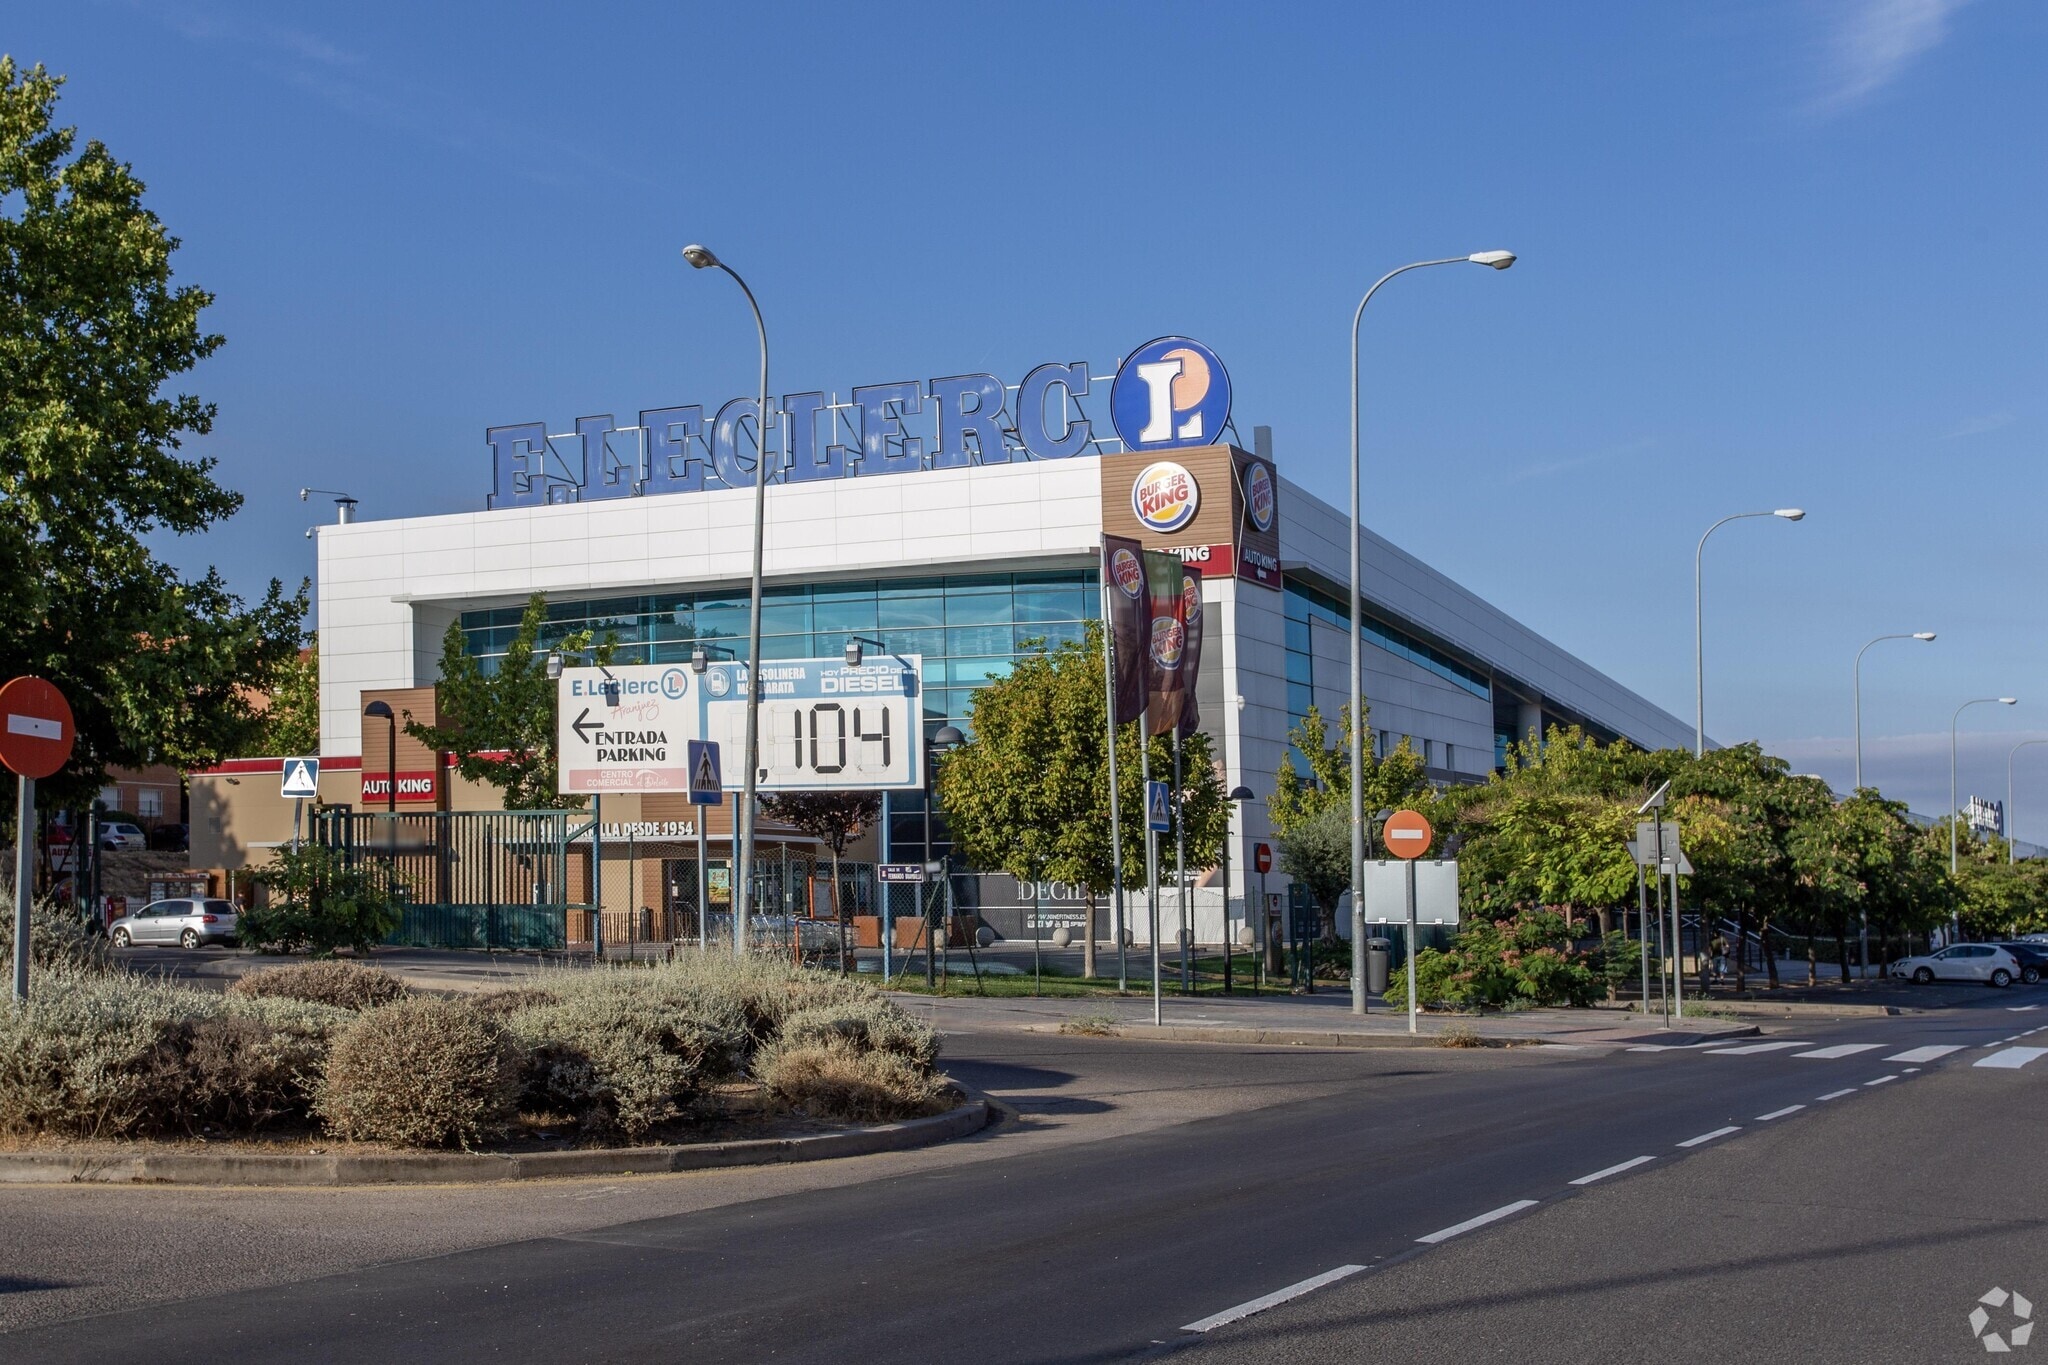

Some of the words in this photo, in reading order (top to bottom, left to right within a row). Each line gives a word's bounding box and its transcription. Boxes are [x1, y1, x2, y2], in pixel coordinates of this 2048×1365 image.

[1140, 473, 1186, 502] BURGER
[1253, 478, 1269, 496] BURGER
[1142, 484, 1189, 519] KING
[1254, 489, 1272, 513] KING
[1115, 560, 1138, 574] BURGER
[1118, 567, 1140, 587] KING
[1152, 627, 1182, 643] BURGER
[1154, 635, 1182, 657] KING
[736, 669, 748, 682] LA
[840, 665, 889, 676] PRECIO
[572, 678, 659, 697] E.Leclerc
[820, 674, 908, 694] DIESEL
[610, 699, 660, 721] Aranjuez
[595, 730, 668, 746] ENTRADA
[596, 747, 666, 762] PARKING
[600, 770, 634, 779] CENTRO
[398, 778, 432, 793] KING
[586, 779, 634, 788] COMERCIAL
[622, 821, 660, 837] DESDE
[662, 820, 694, 836] 1954
